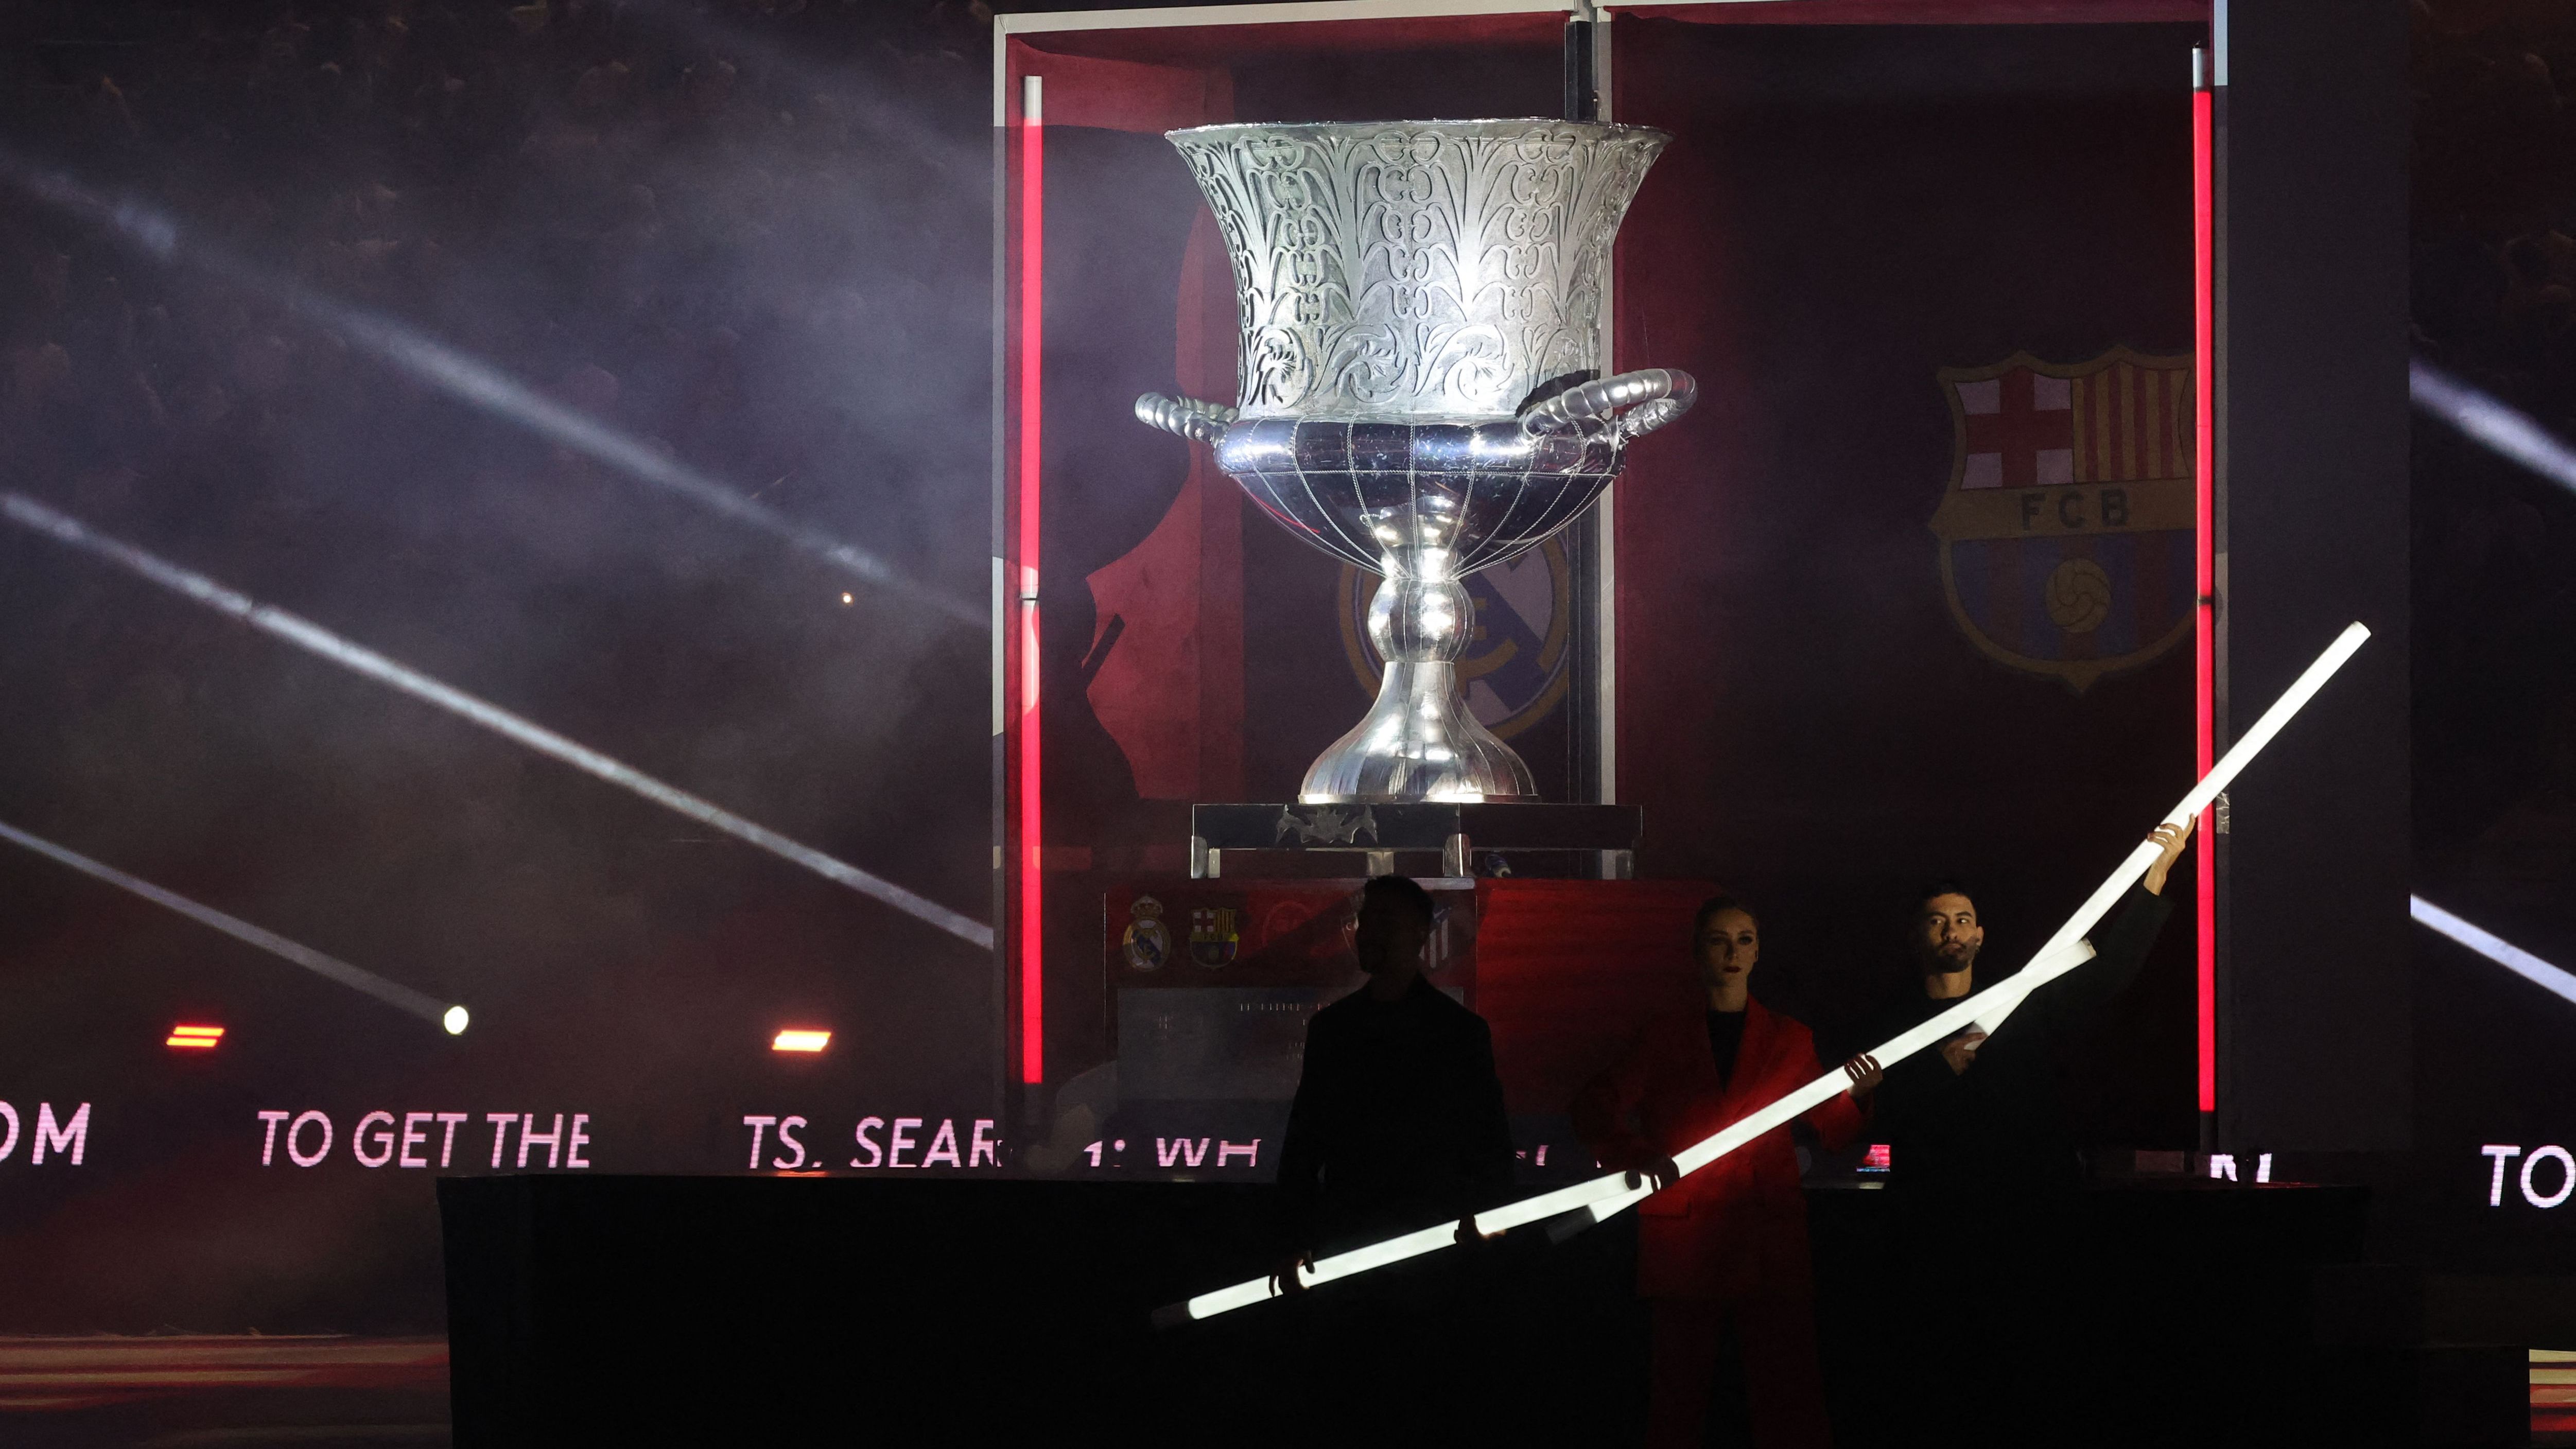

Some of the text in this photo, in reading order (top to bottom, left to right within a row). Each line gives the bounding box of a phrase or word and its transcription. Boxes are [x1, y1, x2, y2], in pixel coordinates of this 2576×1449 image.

[2021, 491, 2129, 531] FCB
[258, 1110, 589, 1168] TO GET THE
[2481, 1144, 2576, 1209] TO
